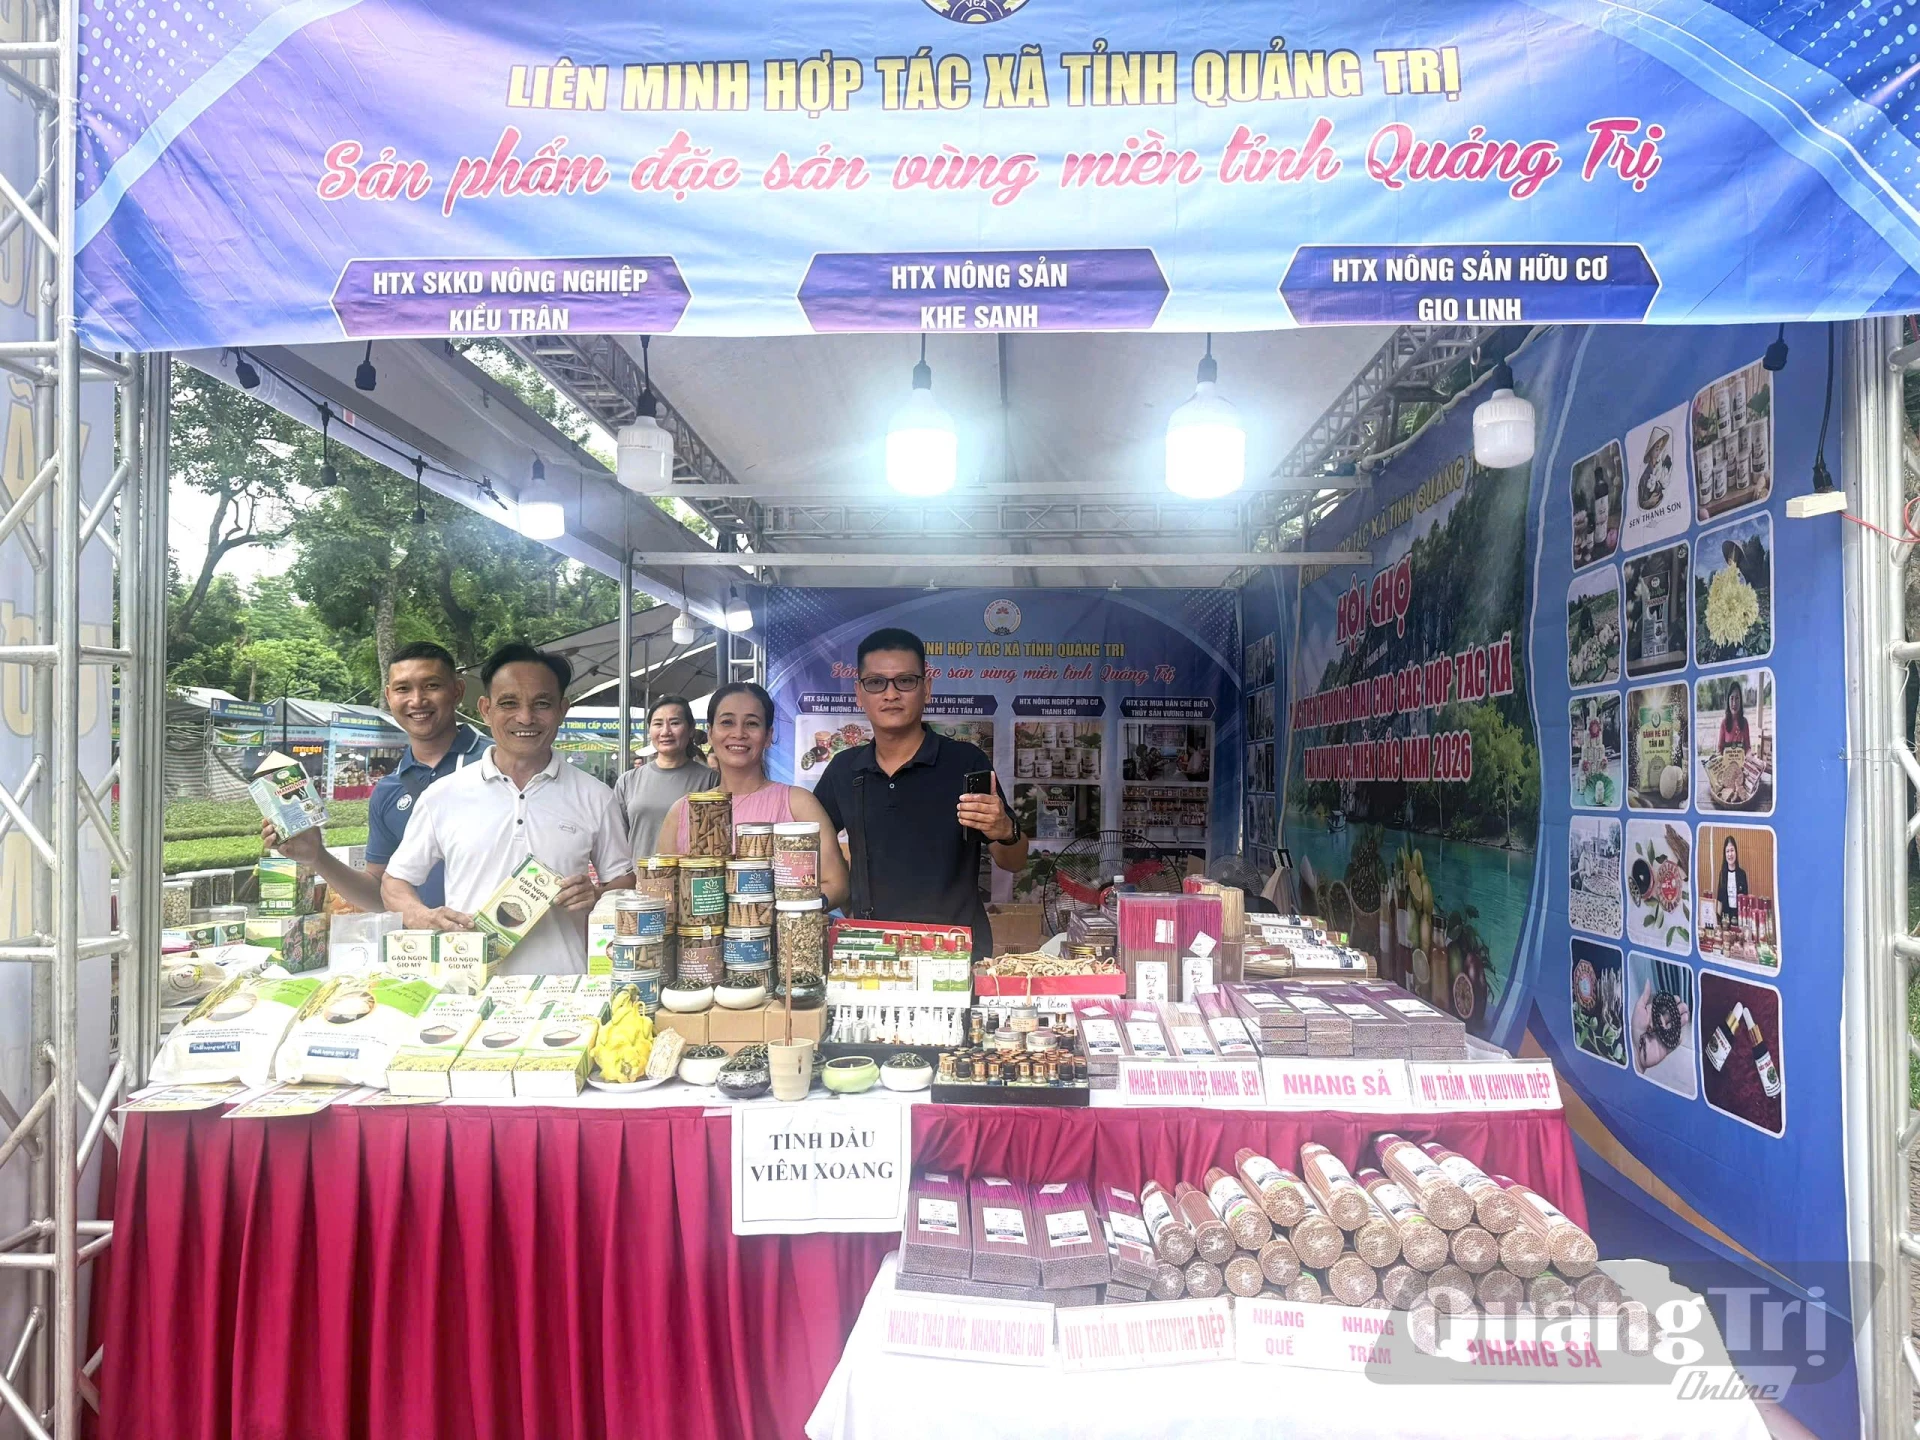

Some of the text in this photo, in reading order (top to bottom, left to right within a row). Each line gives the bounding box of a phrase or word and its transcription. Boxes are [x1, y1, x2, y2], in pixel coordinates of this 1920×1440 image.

[506, 36, 1461, 118] LIÊN MINH HỢP TÁC XÃ TỈNH QUẢNG TRỊ
[317, 116, 1666, 217] Sản phẩm đặc sản vùng miền tỉnh Quảng Trị
[892, 256, 1068, 289] HTX NÔNG SẢN
[1332, 250, 1609, 282] HTX NÔNG SẢN HỮU CƠ
[373, 265, 648, 297] HTX SKKD NÔNG NGHIỆP
[509, 304, 568, 331] TRÂN
[920, 305, 1038, 330] KHE SANH
[1418, 298, 1521, 322] GIO LINH
[1629, 518, 1640, 528] SEN
[1642, 508, 1665, 522] THANH
[1336, 551, 1412, 656] HỘI CHỢ
[947, 640, 973, 658] HỢP
[976, 641, 1000, 656] TÁC
[1104, 642, 1125, 659] TRỊ
[980, 665, 1017, 683] vùng
[1023, 663, 1058, 680] miền
[1153, 663, 1176, 684] Trị
[1319, 683, 1350, 727] THƯƠNG
[1351, 679, 1372, 727] MẠI
[1372, 672, 1395, 718] CHO
[1397, 660, 1422, 714] CÁC
[1424, 651, 1453, 716] HỢP
[1455, 642, 1486, 703] TÁC
[1488, 629, 1514, 698] XÃ
[566, 720, 586, 730] TRÌNH
[588, 719, 601, 730] CẤP
[1351, 729, 1376, 781] MIỀN
[1377, 727, 1400, 782] BẮC
[1402, 730, 1431, 782] NĂM
[1432, 729, 1473, 783] 2026
[519, 884, 530, 895] GIO
[531, 886, 550, 901] NGON
[1128, 1069, 1156, 1095] NHANG
[1156, 1070, 1190, 1095] KHUYNH
[1210, 1070, 1239, 1095] NHANG
[1241, 1069, 1260, 1095] SEN
[1283, 1068, 1392, 1096] NHANG SẢ
[1420, 1075, 1437, 1106] NỤ
[1471, 1074, 1487, 1106] NỤ
[1485, 1074, 1529, 1099] KHUYNH
[1531, 1067, 1551, 1104] DIỆP
[829, 1126, 875, 1148] DẦU
[751, 1159, 893, 1181] VIÊM XOANG
[1253, 1308, 1305, 1328] NHANG
[1342, 1316, 1394, 1336] NHANG
[887, 1310, 920, 1344] NHANG
[970, 1317, 1002, 1353] NHANG
[1146, 1316, 1197, 1353] KHUYNH
[1198, 1307, 1226, 1356] DIỆP
[1265, 1334, 1294, 1356] QUẾ
[1348, 1341, 1392, 1364] TRẦM
[1467, 1331, 1602, 1368] NHANG SẢ
